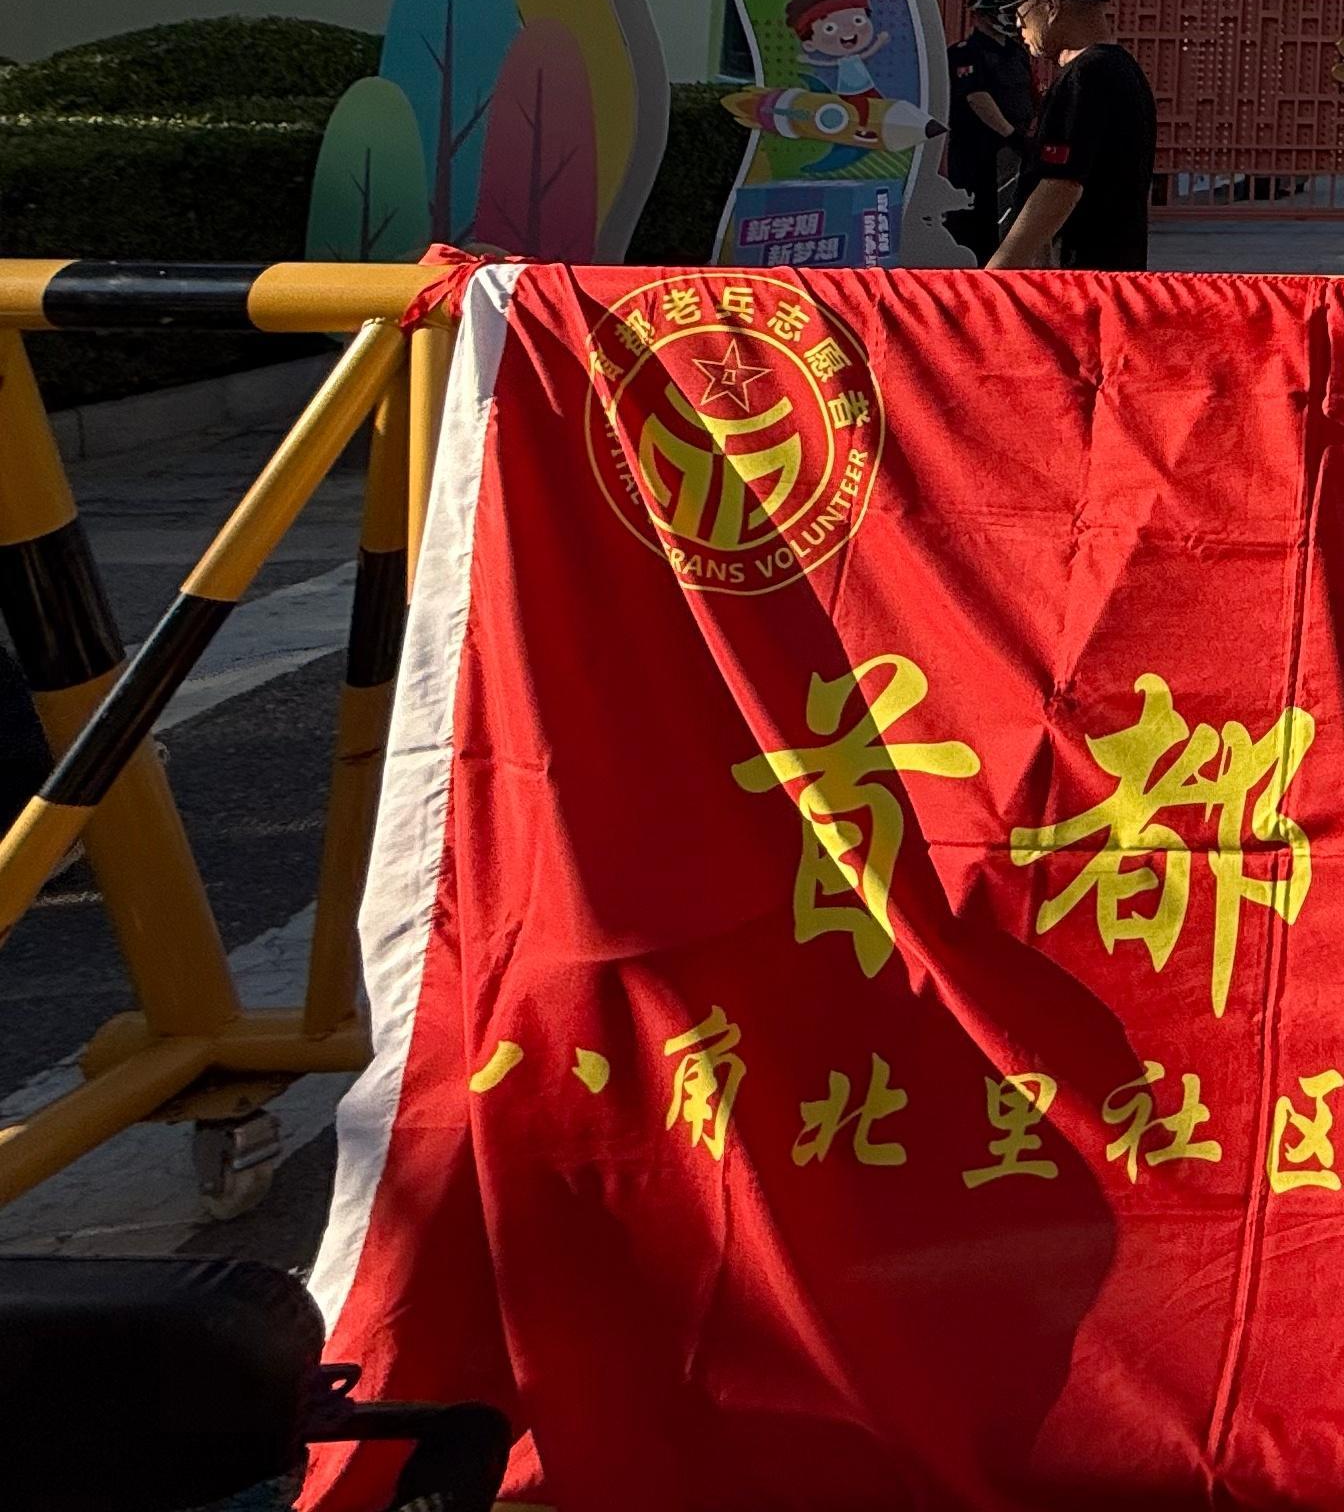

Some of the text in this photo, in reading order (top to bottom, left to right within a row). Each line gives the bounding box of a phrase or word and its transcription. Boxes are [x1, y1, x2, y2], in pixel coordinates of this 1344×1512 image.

[745, 212, 820, 244] 新学期
[767, 237, 840, 267] 新梦想
[754, 448, 868, 579] VOLUNTEER
